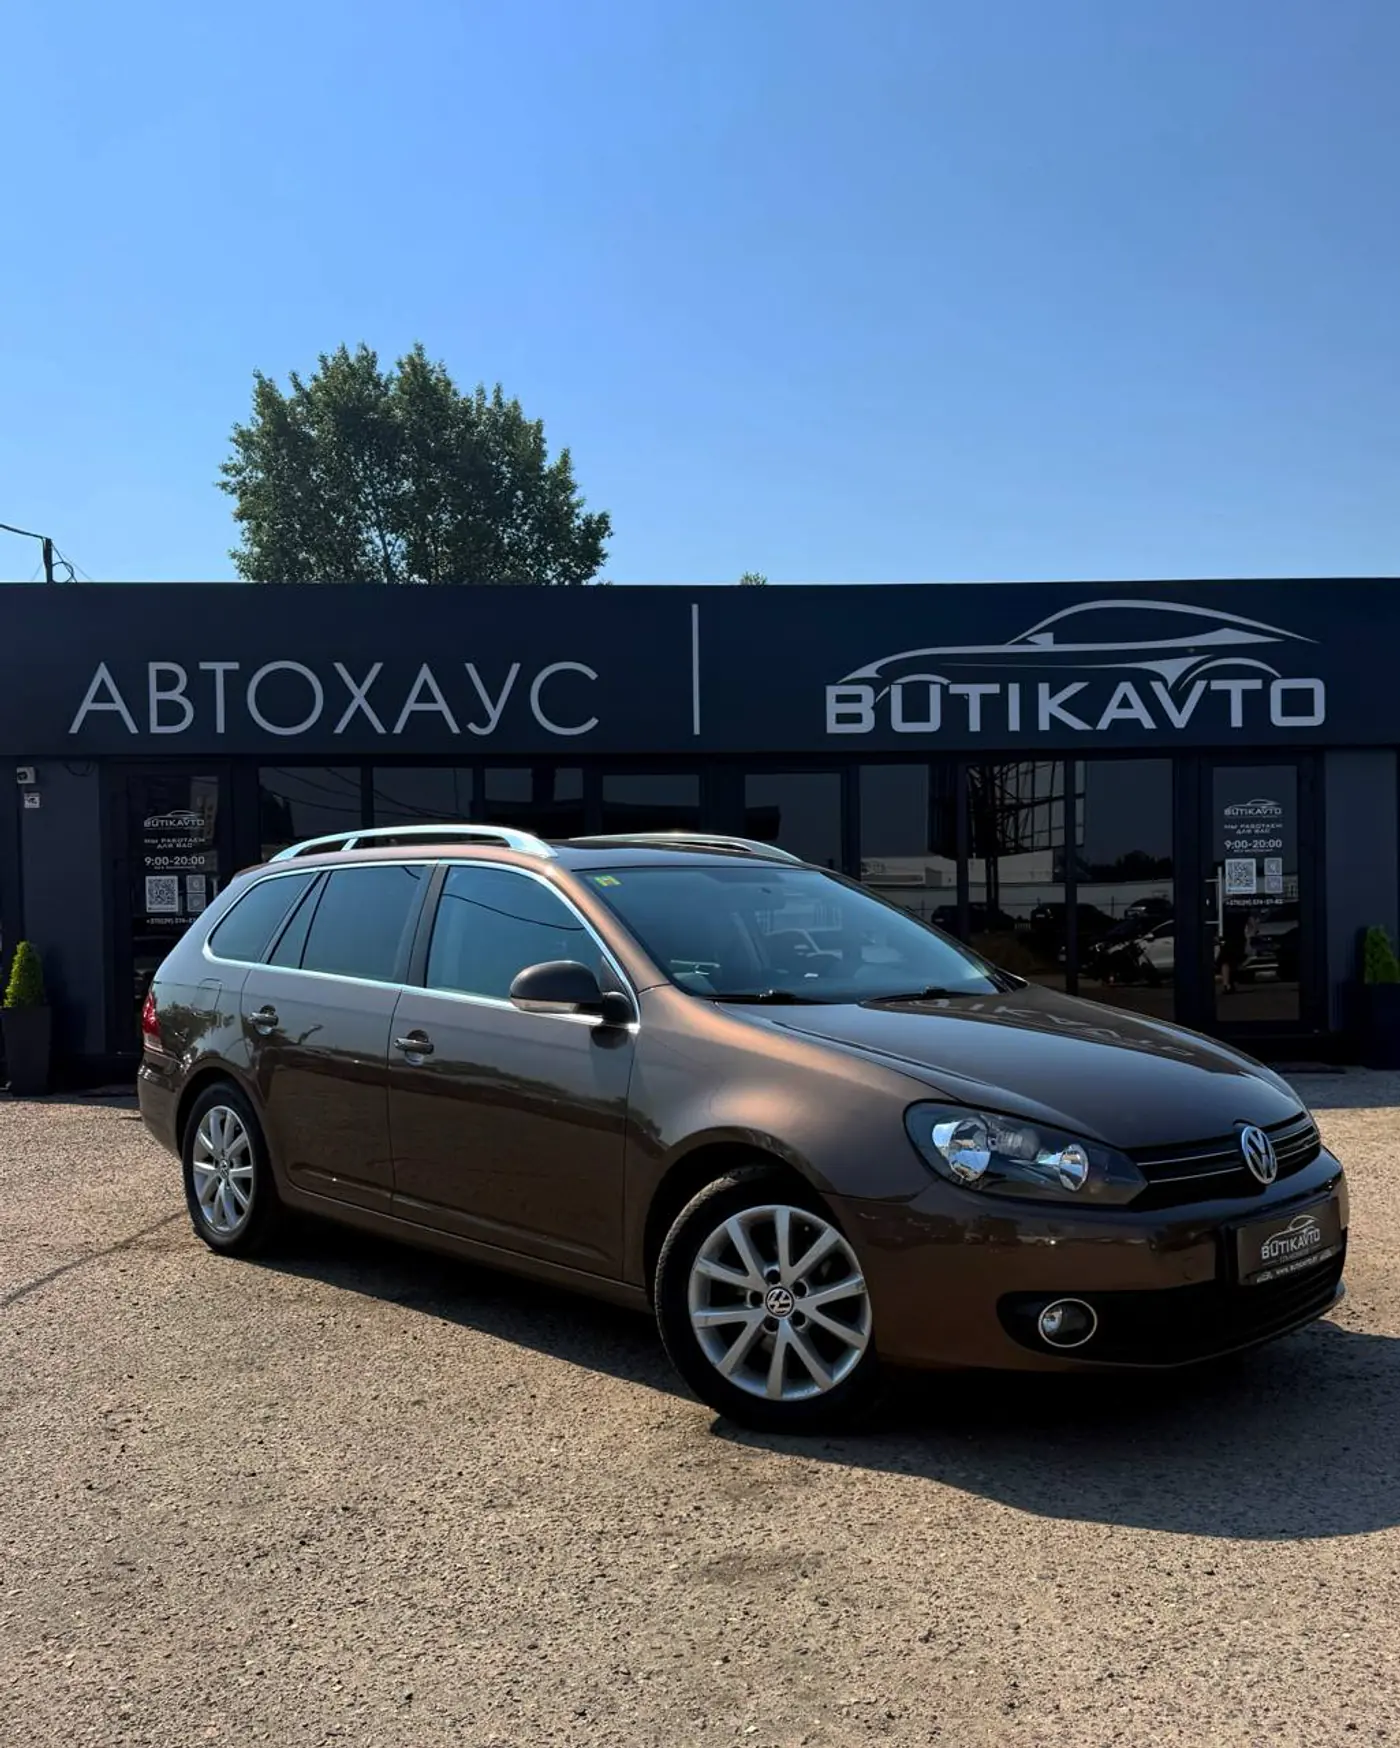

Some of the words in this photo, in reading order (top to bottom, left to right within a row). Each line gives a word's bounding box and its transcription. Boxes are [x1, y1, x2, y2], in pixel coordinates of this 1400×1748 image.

[68, 660, 599, 735] АВТОХАУС
[825, 677, 1326, 734] BUTIKAVTO
[1223, 807, 1282, 816] BUTIKAVTO
[143, 818, 205, 828] BUTIKAVTO
[1223, 838, 1283, 850] 9:00-20:00
[144, 855, 205, 866] 9:00-20:00
[1261, 1227, 1321, 1260] BUTIKAVTO
